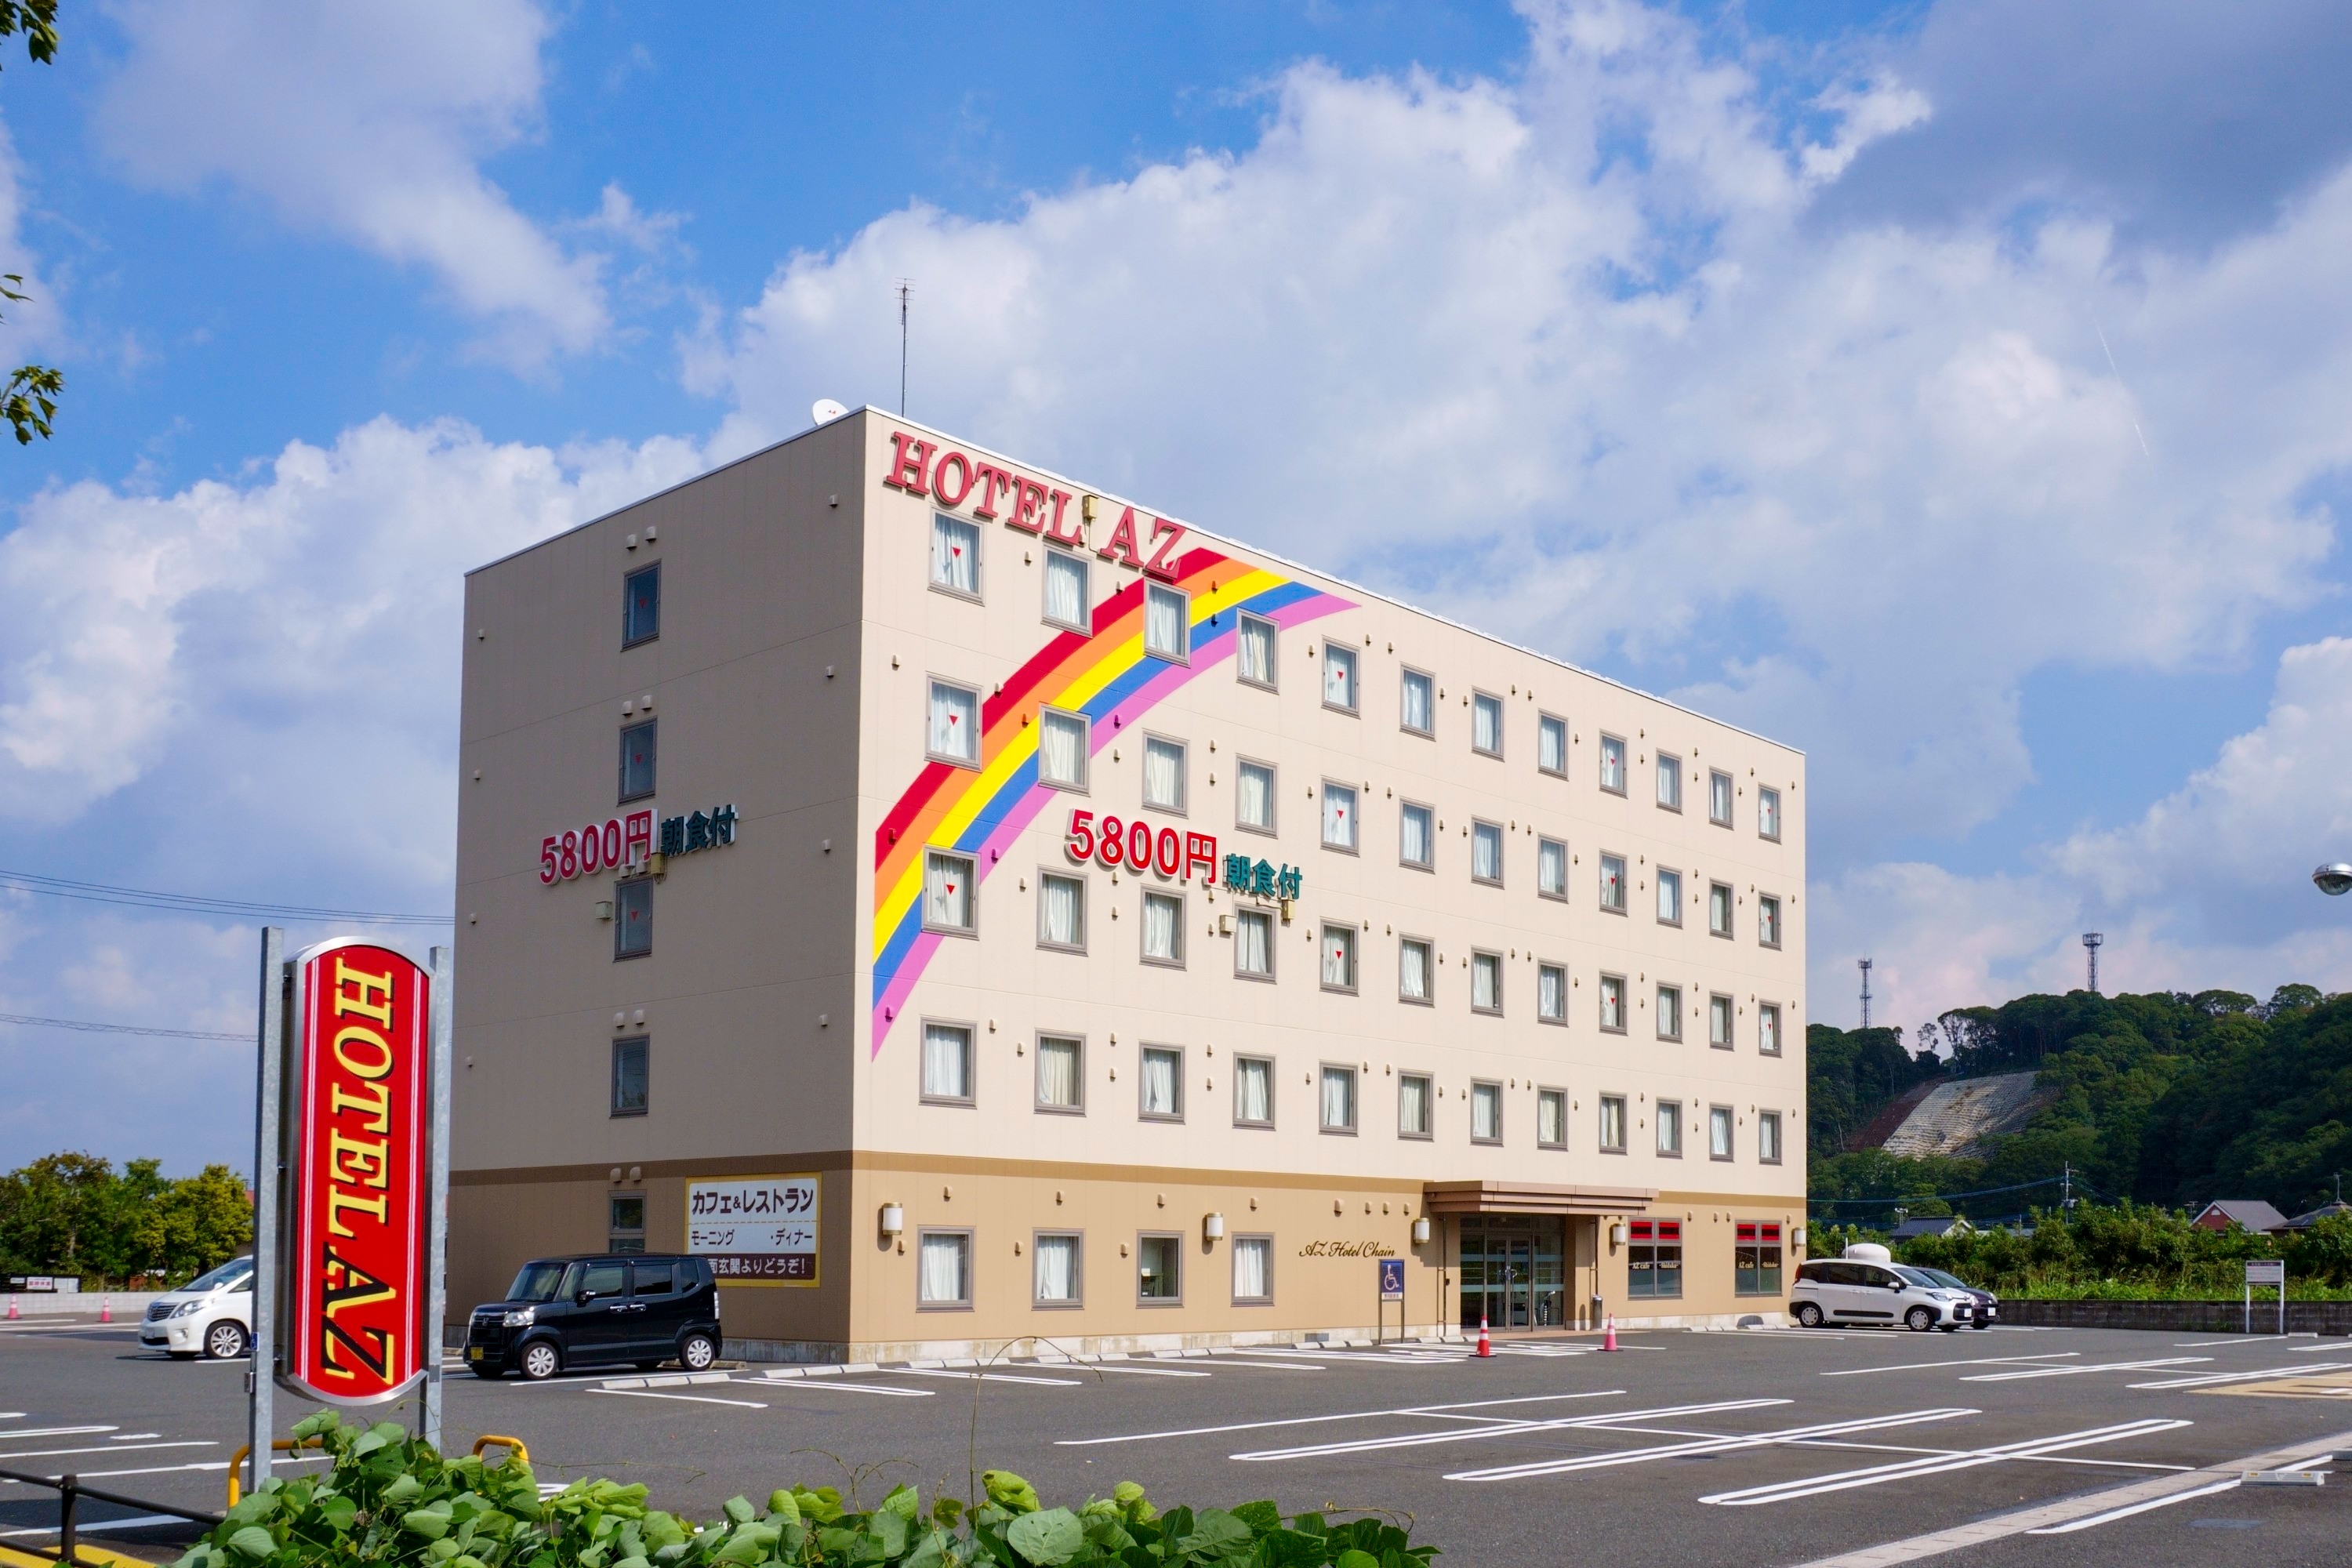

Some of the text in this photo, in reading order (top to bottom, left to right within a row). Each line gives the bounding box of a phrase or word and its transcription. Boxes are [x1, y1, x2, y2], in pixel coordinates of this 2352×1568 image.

[884, 431, 1186, 580] HOTEL AZ
[539, 804, 739, 885] 5800円 朝食付
[1065, 808, 1302, 899] 5800円 朝食付
[321, 957, 397, 1385] HOTEL AZ
[691, 1188, 814, 1215] カフェ&レストラン
[691, 1229, 735, 1246] モーニング
[1298, 1240, 1396, 1258] AZ Hotel Chain
[707, 1258, 805, 1275] 面玄関よりどうぞ!
